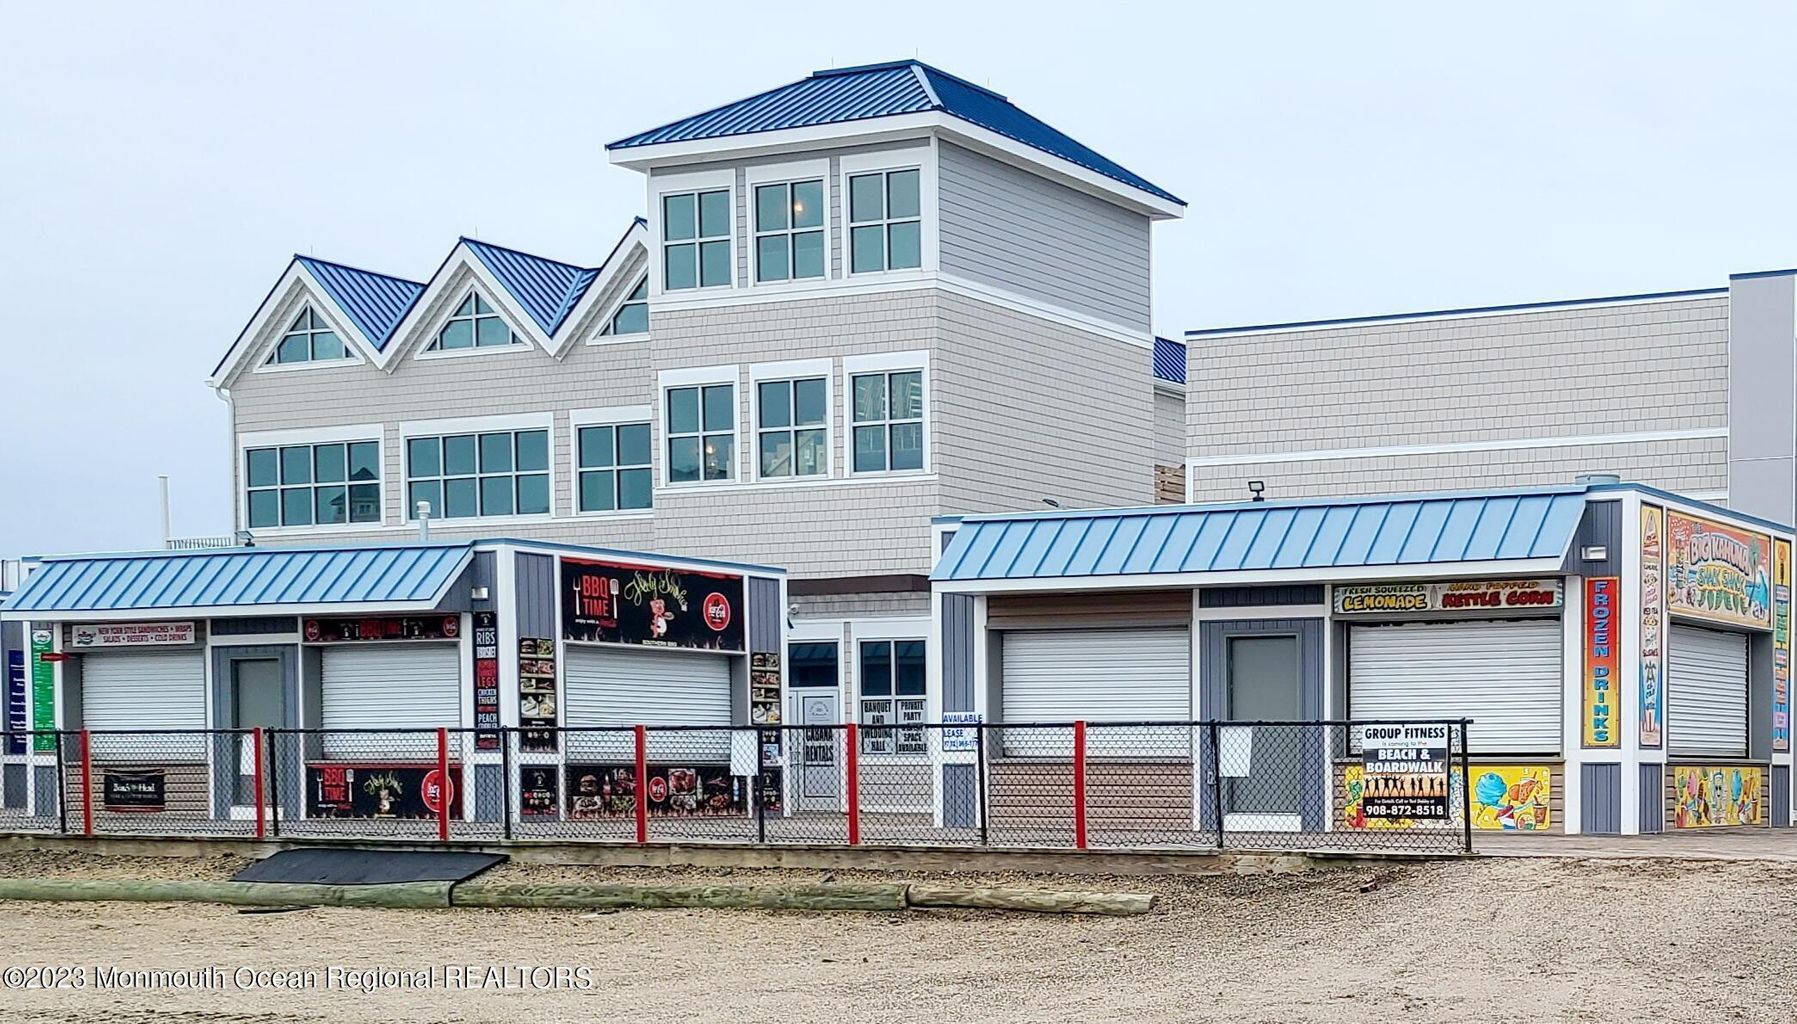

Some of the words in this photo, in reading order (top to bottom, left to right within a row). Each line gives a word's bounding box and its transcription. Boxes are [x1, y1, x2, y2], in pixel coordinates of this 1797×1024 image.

[1689, 534, 1709, 565] BIG
[1711, 534, 1750, 576] KAHUNA
[582, 575, 608, 598] BBQ
[1343, 586, 1372, 595] FRESH
[1374, 585, 1424, 594] SQUEEZED
[1343, 593, 1427, 610] LEMONADE
[1442, 592, 1501, 608] KETTLE
[1506, 590, 1554, 605] CORN
[584, 598, 609, 616] TIME
[1592, 581, 1611, 658] FROZEN
[476, 632, 496, 645] RIBS
[864, 702, 892, 714] BANQUET
[900, 701, 924, 710] PRIVATE
[1593, 666, 1610, 742] DRINKS
[478, 714, 498, 722] PEACH
[872, 714, 885, 724] AND
[904, 712, 922, 721] PARTY
[943, 714, 983, 723] AVAILABLE
[806, 728, 834, 742] CABANA
[904, 733, 922, 742] SPACE
[1365, 728, 1402, 739] GROUP
[1404, 728, 1445, 738] FITNESS
[871, 740, 886, 752] HALL
[898, 744, 928, 752] AVAILABLE
[806, 745, 834, 762] RENTALS
[1378, 749, 1417, 760] BEACH
[1420, 748, 1430, 760] &
[1366, 762, 1443, 773] BOARDWALK
[324, 768, 345, 786] BBQ
[324, 787, 345, 800] TIME
[1366, 805, 1444, 816] 908-872-8518
